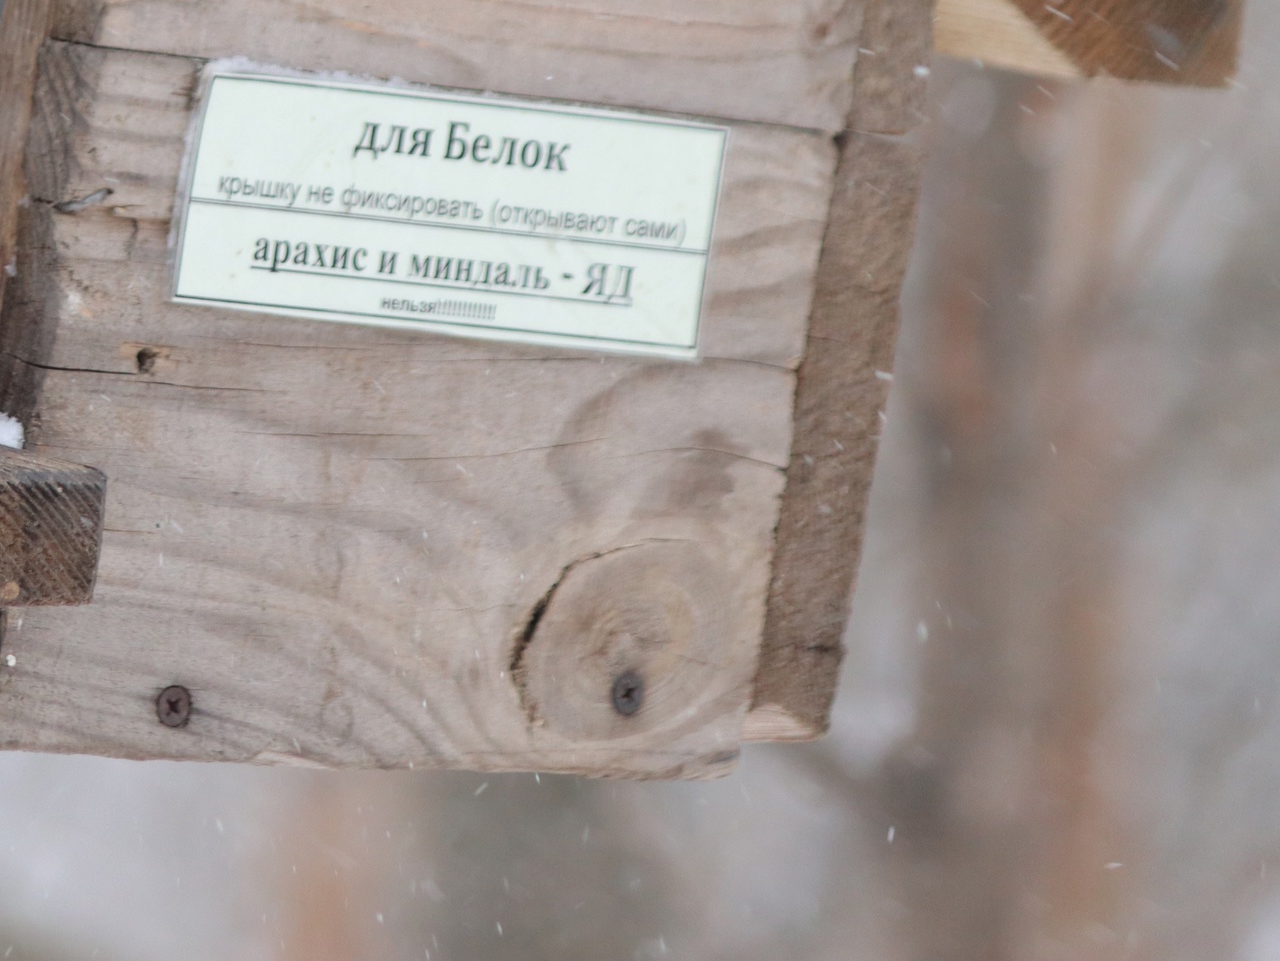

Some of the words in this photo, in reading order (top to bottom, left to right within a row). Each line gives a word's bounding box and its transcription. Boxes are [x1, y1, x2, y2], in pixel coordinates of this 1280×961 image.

[353, 120, 434, 159] для
[444, 122, 571, 172] Белок
[217, 174, 300, 205] крышку
[305, 186, 335, 204] не
[341, 184, 484, 221] фиксировать
[490, 199, 618, 237] (открывают
[624, 214, 687, 247] сами)
[252, 238, 368, 273] арахис
[377, 252, 399, 275] и
[408, 257, 551, 290] миндаль
[581, 264, 637, 301] ЯД
